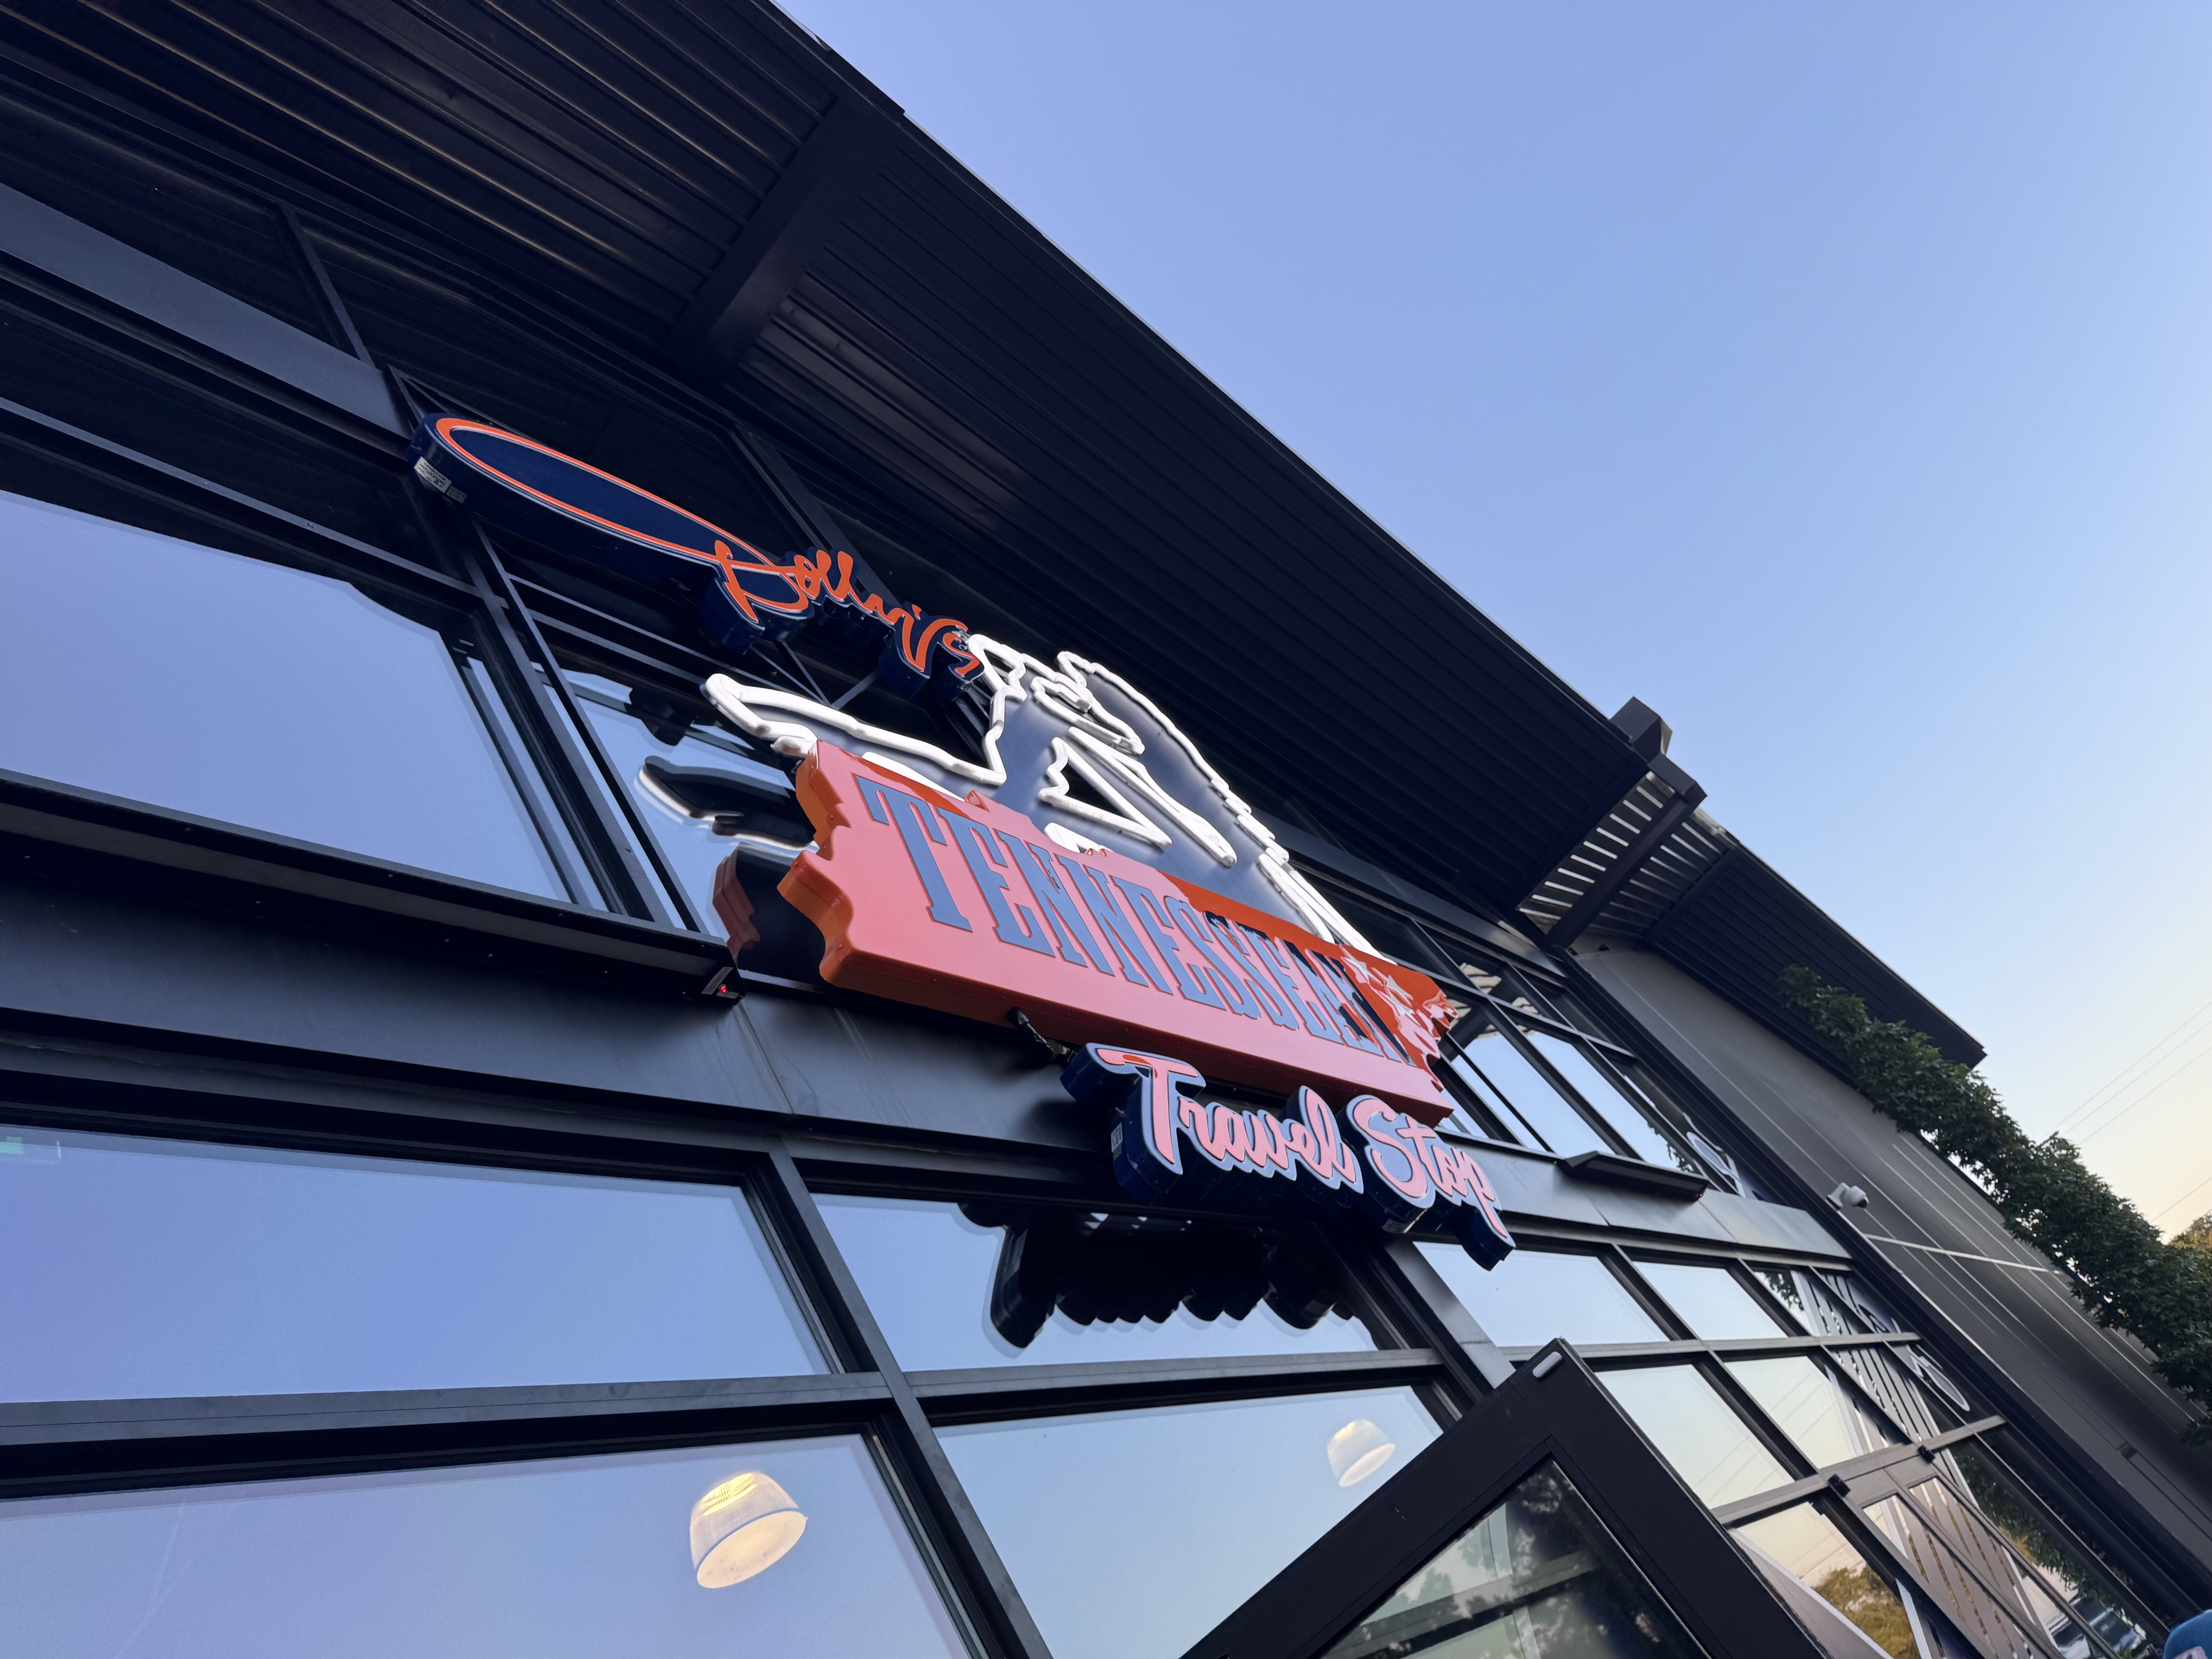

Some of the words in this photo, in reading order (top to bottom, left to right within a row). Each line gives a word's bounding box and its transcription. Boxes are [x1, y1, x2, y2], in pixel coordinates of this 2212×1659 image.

[851, 774, 1417, 1067] TENNESSEAN
[1095, 1046, 1358, 1185] Travel
[1352, 1097, 1509, 1239] Stop
